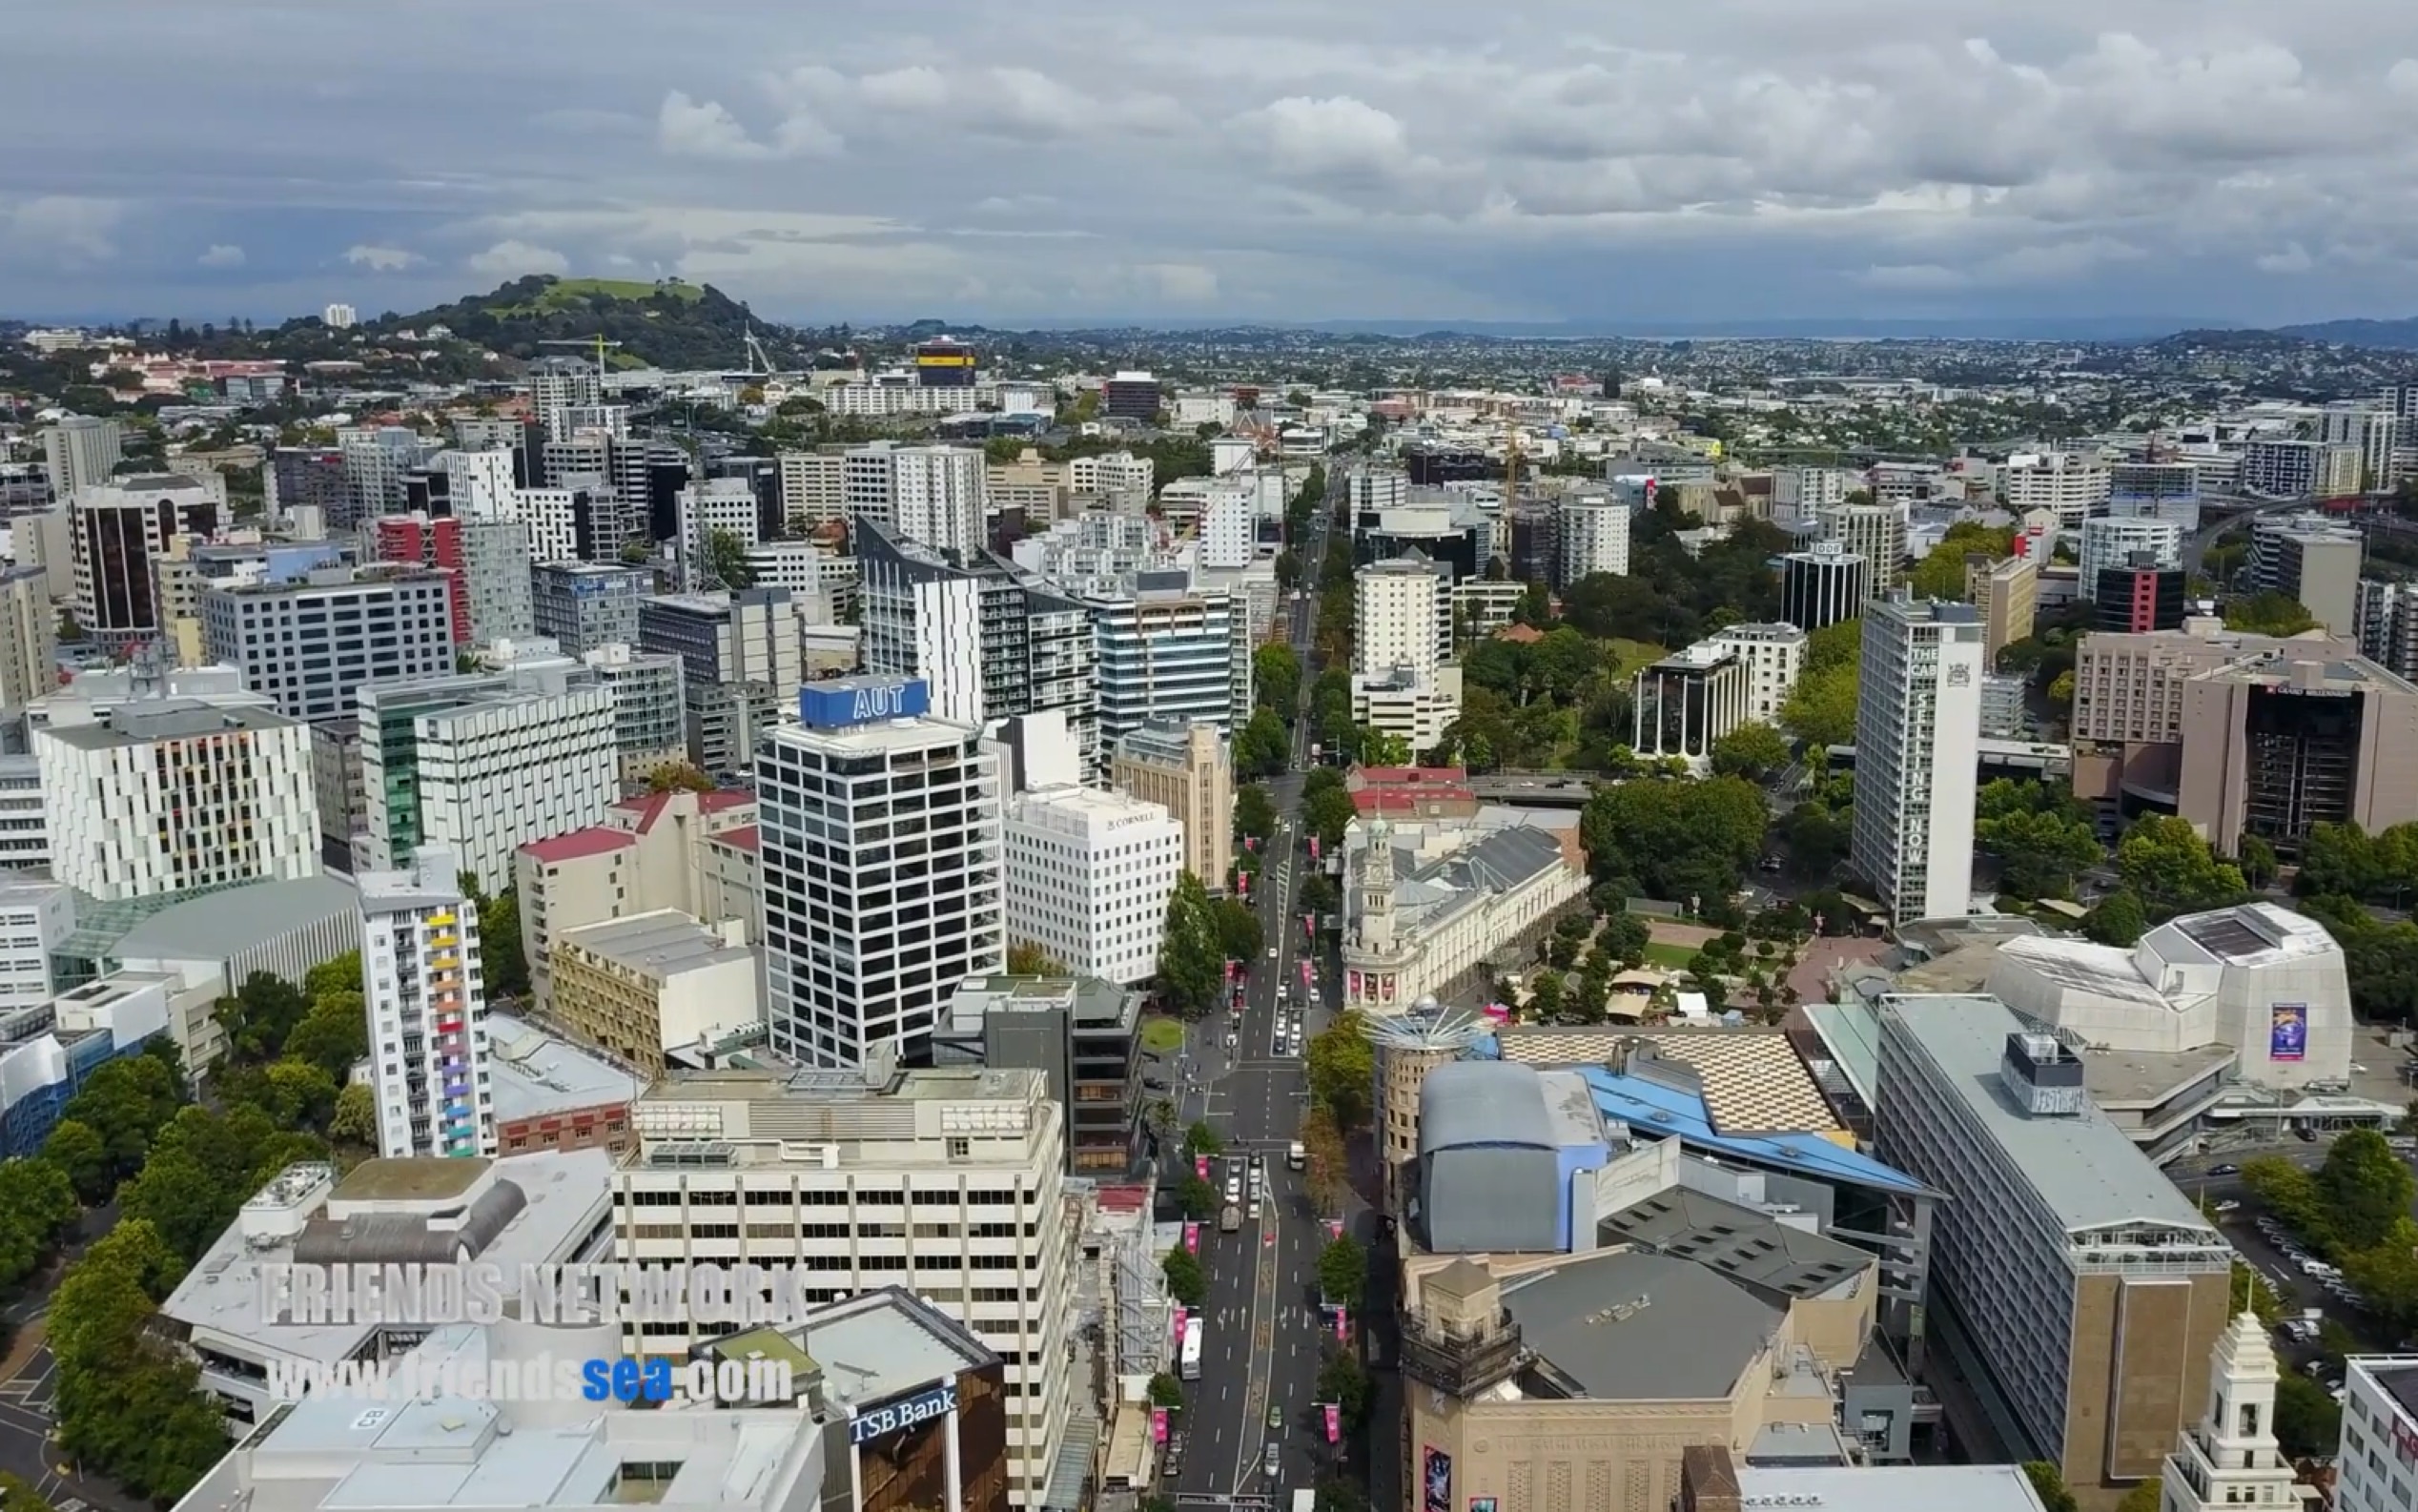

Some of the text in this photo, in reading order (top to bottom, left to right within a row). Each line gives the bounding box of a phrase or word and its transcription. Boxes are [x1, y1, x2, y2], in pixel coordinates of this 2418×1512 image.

[1912, 649, 1938, 660] THE
[1912, 664, 1937, 676] CAB
[853, 684, 906, 719] AUT
[1908, 693, 1927, 863] SELLING NOW
[1116, 811, 1155, 828] CORNELL
[849, 1389, 959, 1442] TSB Bank
